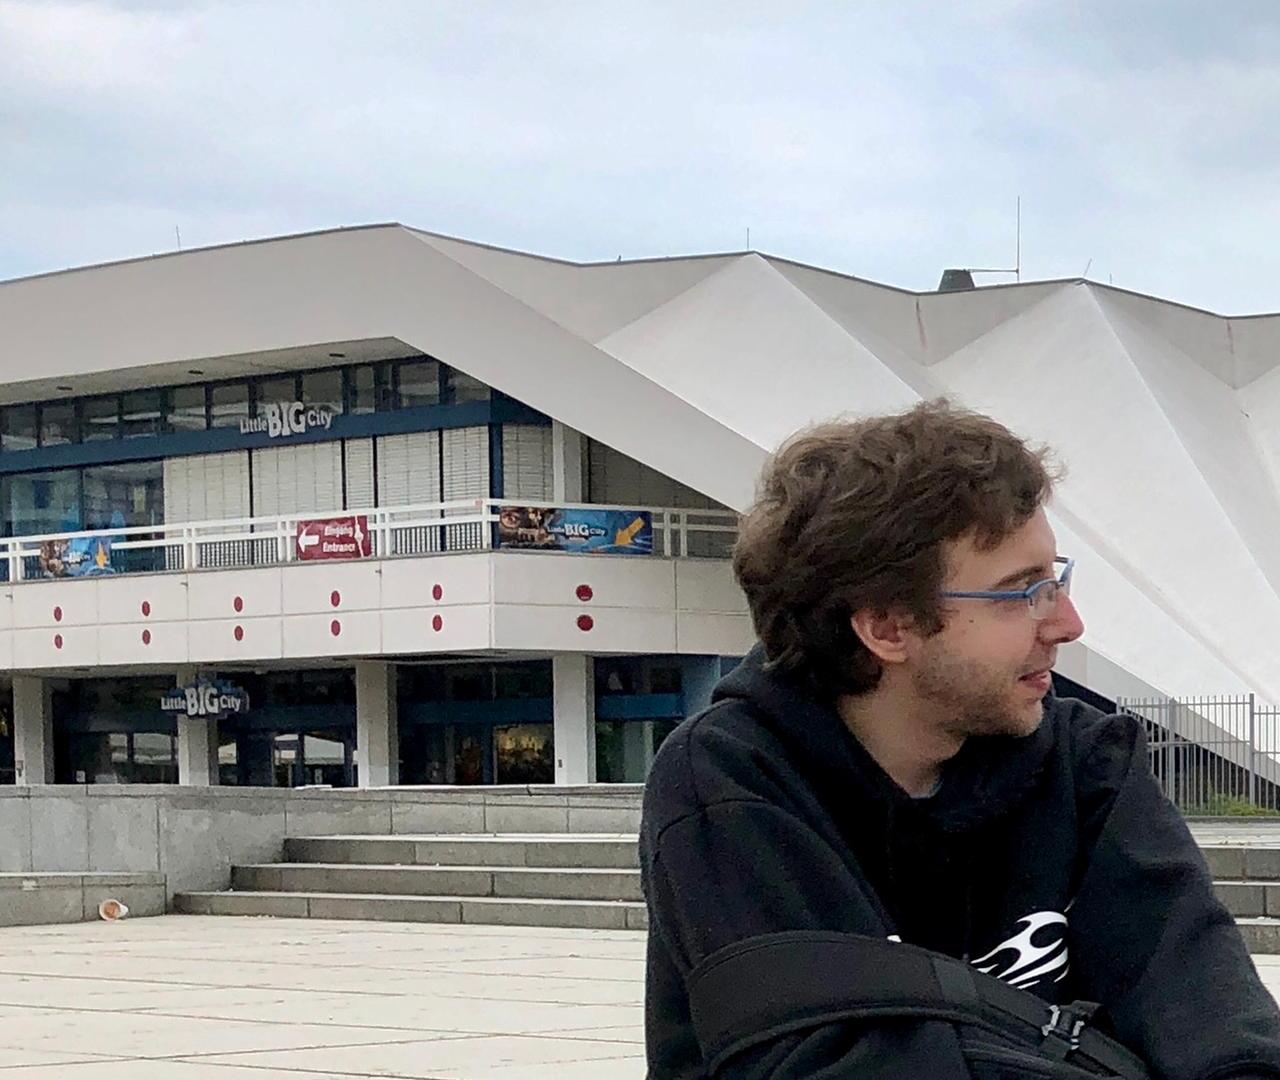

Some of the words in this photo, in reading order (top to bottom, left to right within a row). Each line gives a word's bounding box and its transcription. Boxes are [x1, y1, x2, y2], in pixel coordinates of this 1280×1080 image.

[240, 417, 268, 434] Little
[265, 401, 306, 438] BIG
[307, 410, 333, 429] City
[564, 523, 589, 536] BIG
[161, 697, 186, 710] Little
[185, 686, 219, 716] BIG
[220, 694, 241, 712] City
